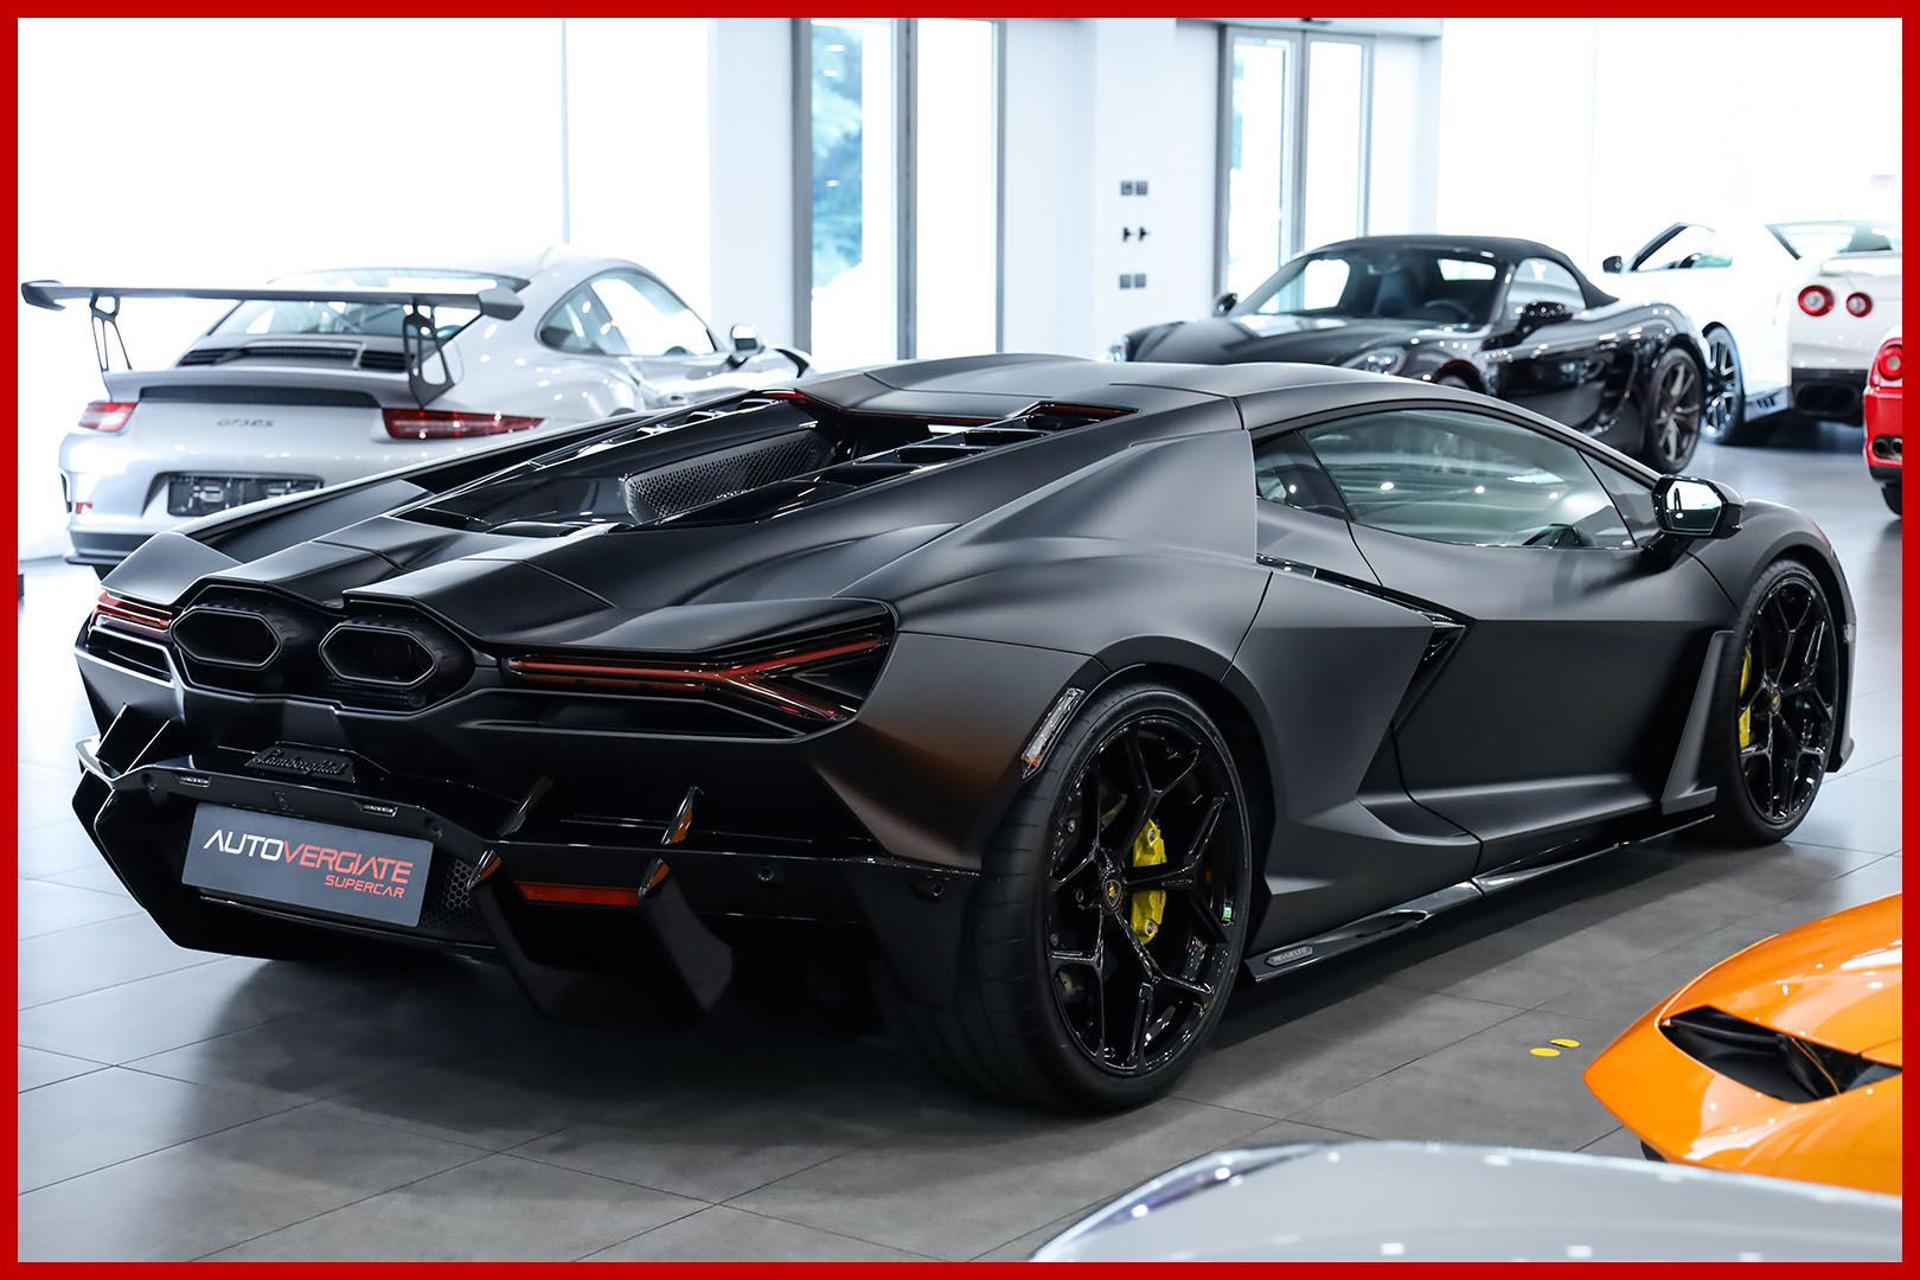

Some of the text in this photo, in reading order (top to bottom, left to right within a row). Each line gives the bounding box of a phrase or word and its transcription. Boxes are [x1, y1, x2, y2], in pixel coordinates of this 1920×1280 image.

[252, 749, 346, 775] Lamborghini
[203, 829, 413, 884] AUTOVERGIATE
[325, 874, 405, 898] SUPERCAR
